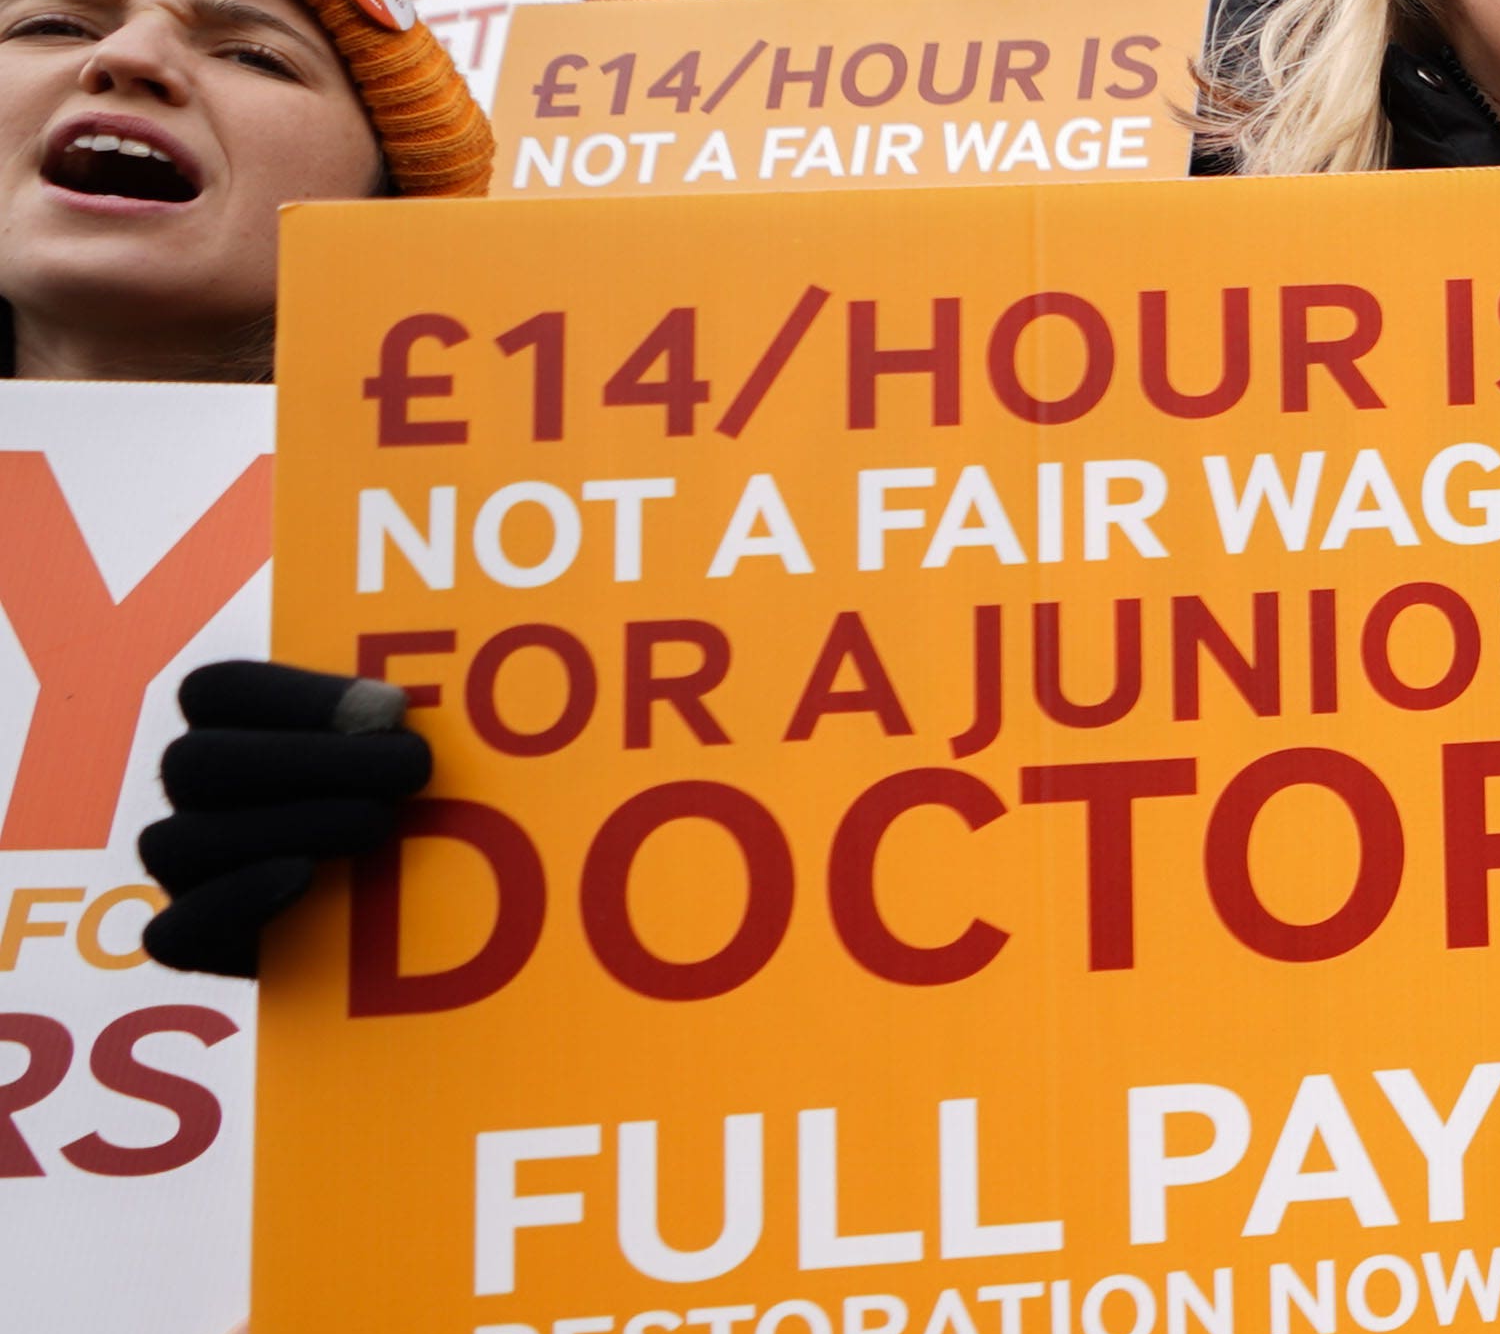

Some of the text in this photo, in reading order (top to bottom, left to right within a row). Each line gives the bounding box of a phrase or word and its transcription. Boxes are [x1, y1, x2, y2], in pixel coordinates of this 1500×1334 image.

[533, 35, 1161, 118] £14/HOUR IS
[512, 117, 1153, 189] NOT A FAIR WAGE
[361, 282, 1387, 449] £14/HOUR
[356, 478, 676, 594] NOT
[706, 473, 816, 580] A
[857, 459, 1171, 571] FAIR
[356, 618, 733, 758] FOR
[783, 610, 916, 743] A
[473, 1097, 1064, 1298] FULL
